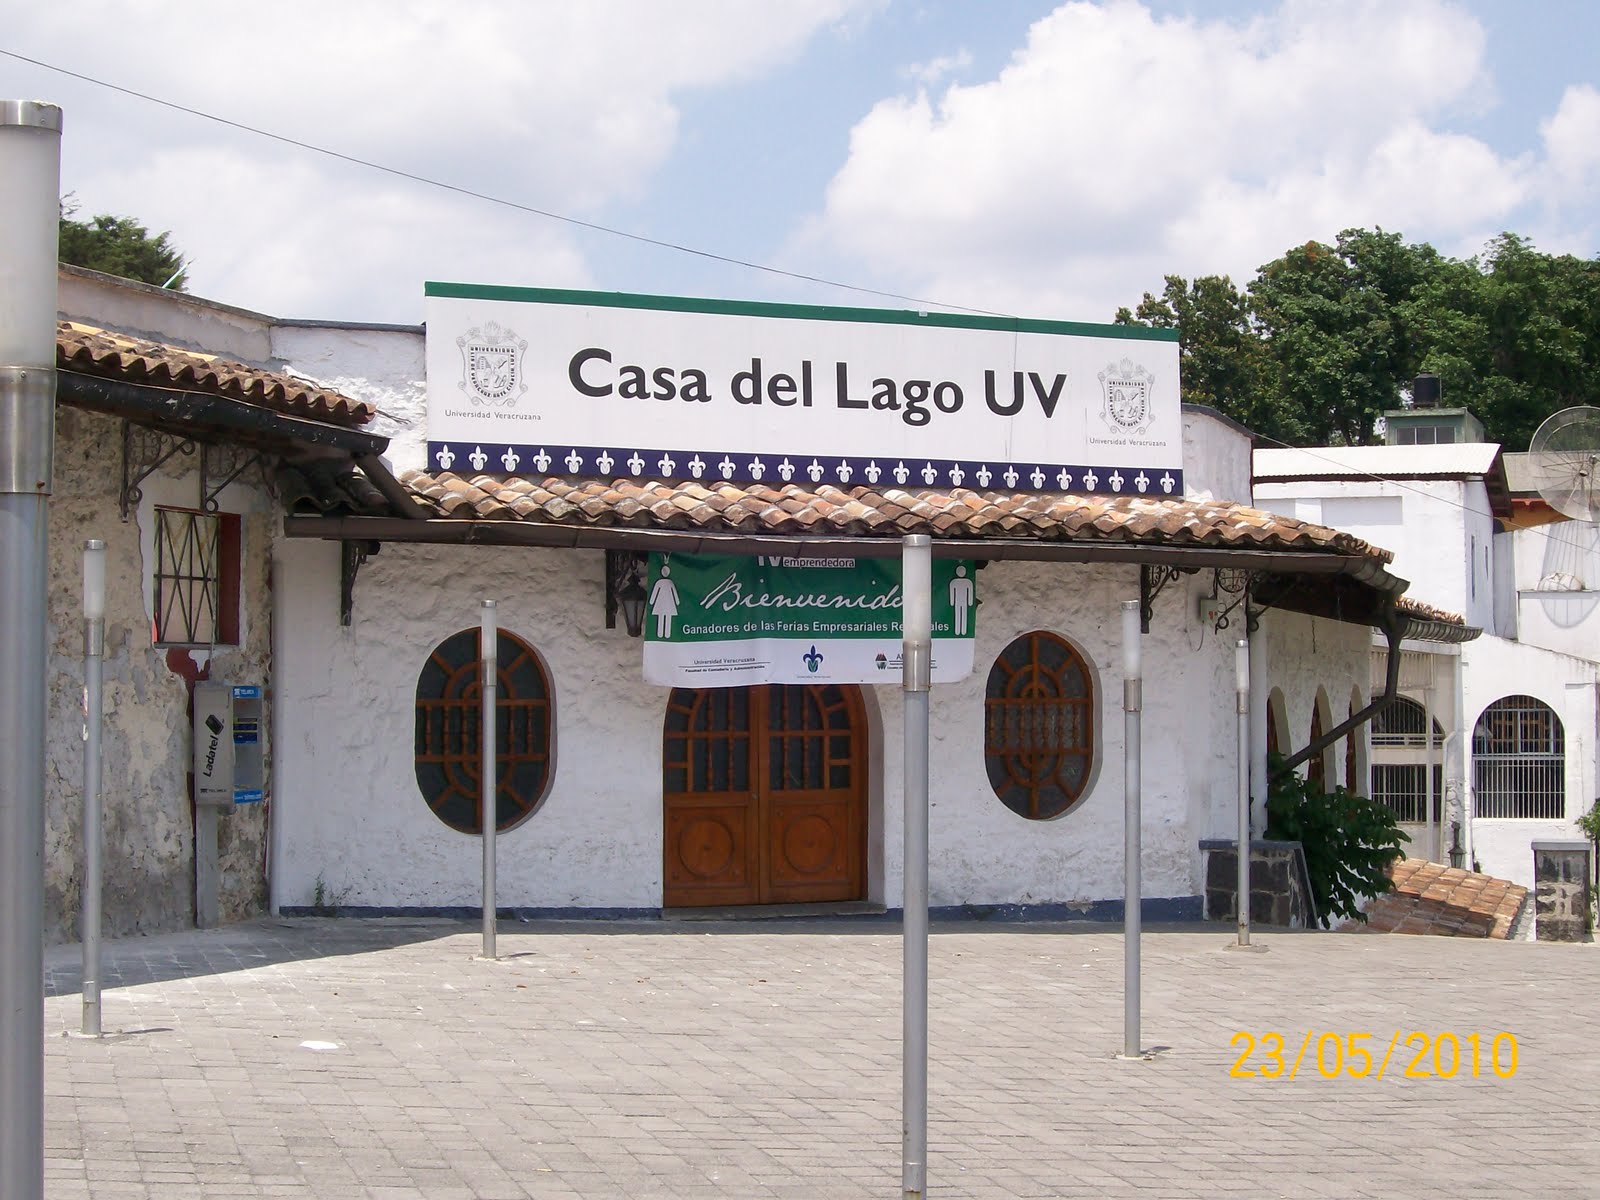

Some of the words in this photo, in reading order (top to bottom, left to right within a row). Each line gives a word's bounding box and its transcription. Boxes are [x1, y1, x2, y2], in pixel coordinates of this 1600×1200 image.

[568, 347, 711, 403] Casa
[731, 357, 812, 408] del
[836, 361, 964, 427] Lago
[984, 369, 1067, 419] UV
[444, 409, 491, 420] Universidad
[494, 411, 542, 421] Veracruzana
[1089, 437, 1127, 446] Universidad
[1129, 439, 1167, 447] Veracruzana
[783, 557, 855, 569] emprendedora
[700, 572, 903, 612] Bienvenido
[682, 623, 740, 635] Ganadores
[743, 621, 757, 632] de
[761, 620, 775, 631] las
[777, 620, 809, 631] Ferias
[813, 621, 888, 635] Empresariales
[891, 622, 949, 632] Reales
[203, 735, 219, 778] Ladatel
